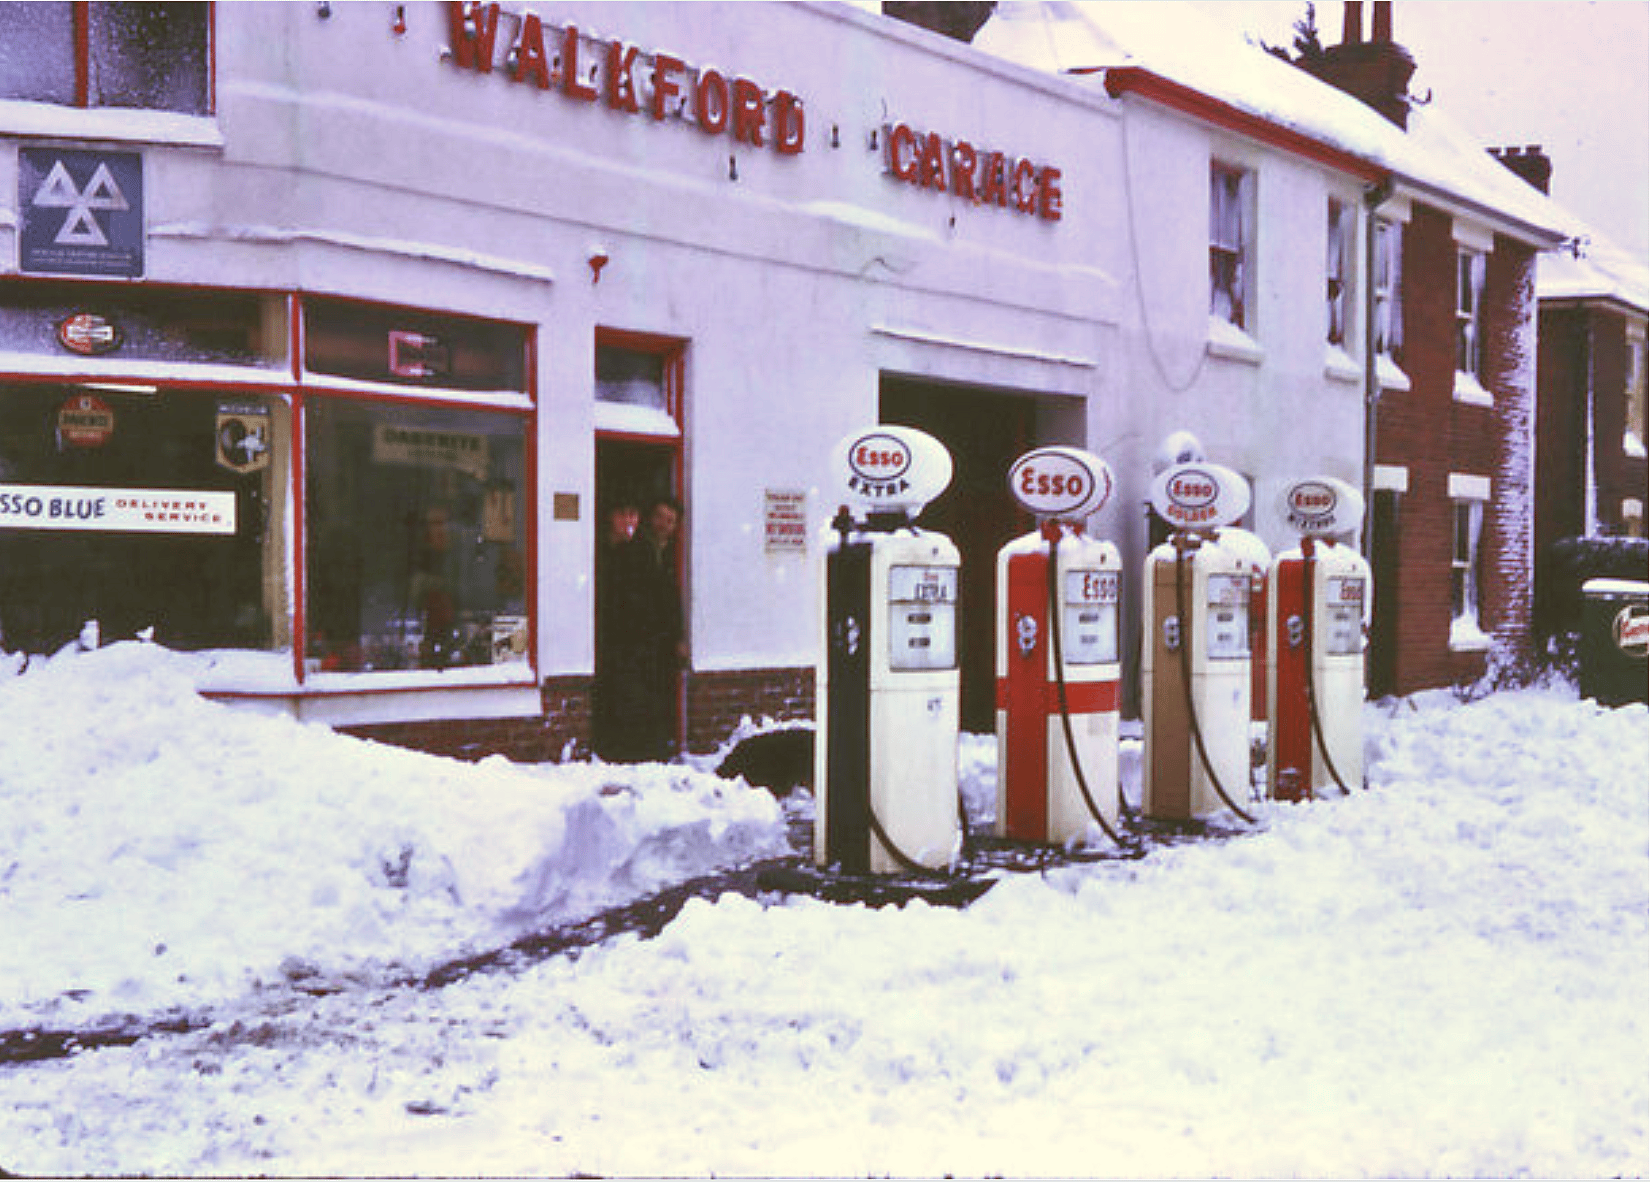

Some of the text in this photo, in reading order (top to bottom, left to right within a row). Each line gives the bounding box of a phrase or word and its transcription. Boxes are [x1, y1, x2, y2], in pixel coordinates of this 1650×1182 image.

[447, 0, 1062, 221] WALKFORD GARAGE
[856, 446, 903, 467] Esso
[848, 476, 911, 497] EXTRA
[1021, 466, 1083, 496] Esso
[1172, 480, 1213, 498] Esso
[49, 496, 105, 519] BLUE
[115, 498, 207, 511] DELIVERY
[1295, 493, 1332, 507] Esso
[144, 511, 222, 524] SERVICE
